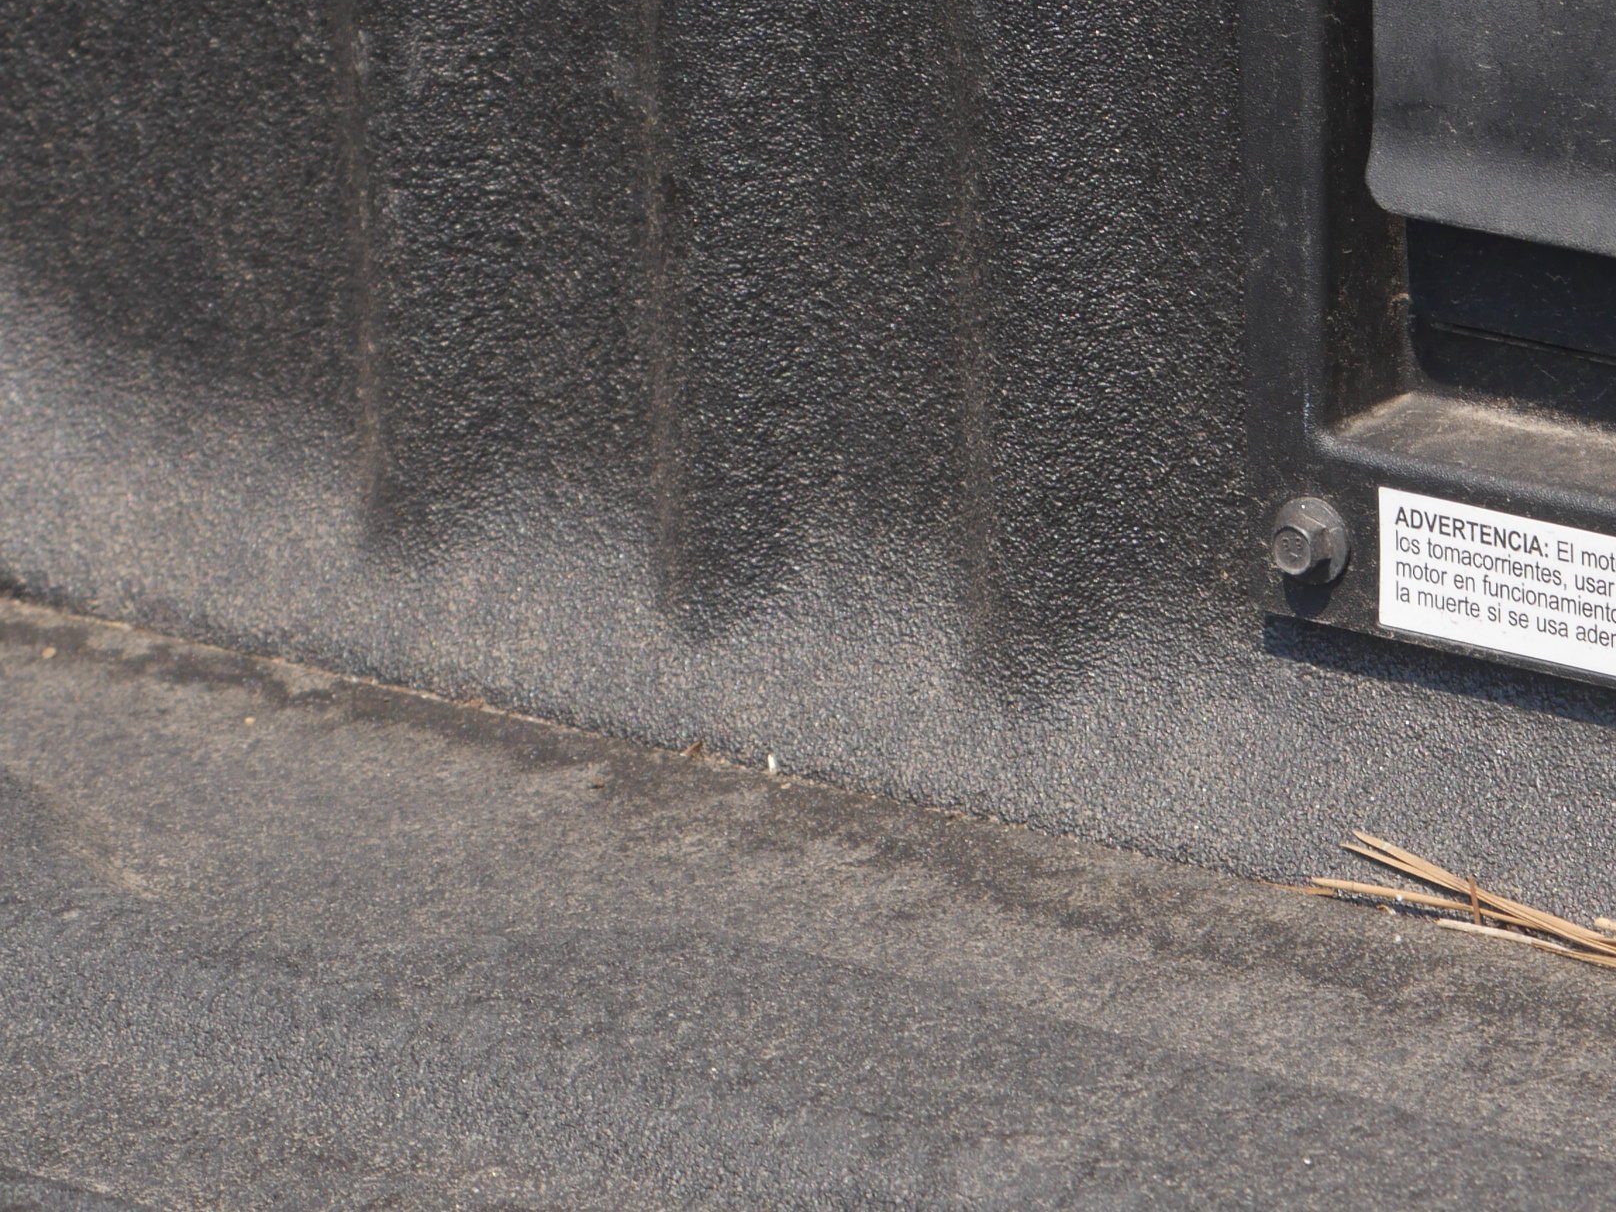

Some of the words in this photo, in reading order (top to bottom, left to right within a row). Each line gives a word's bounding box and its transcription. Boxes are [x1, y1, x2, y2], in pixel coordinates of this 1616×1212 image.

[1395, 507, 1549, 558] ADVERTENCIA:
[1557, 541, 1573, 562] El
[1395, 531, 1420, 554] los
[1427, 538, 1567, 590] tomacorrientes,
[1574, 573, 1614, 597] usar
[1396, 561, 1447, 586] motor
[1454, 574, 1475, 592] en
[1396, 580, 1410, 603] la
[1418, 590, 1480, 618] muerte
[1487, 604, 1501, 623] si
[1508, 610, 1529, 629] se
[1536, 618, 1568, 637] usa
